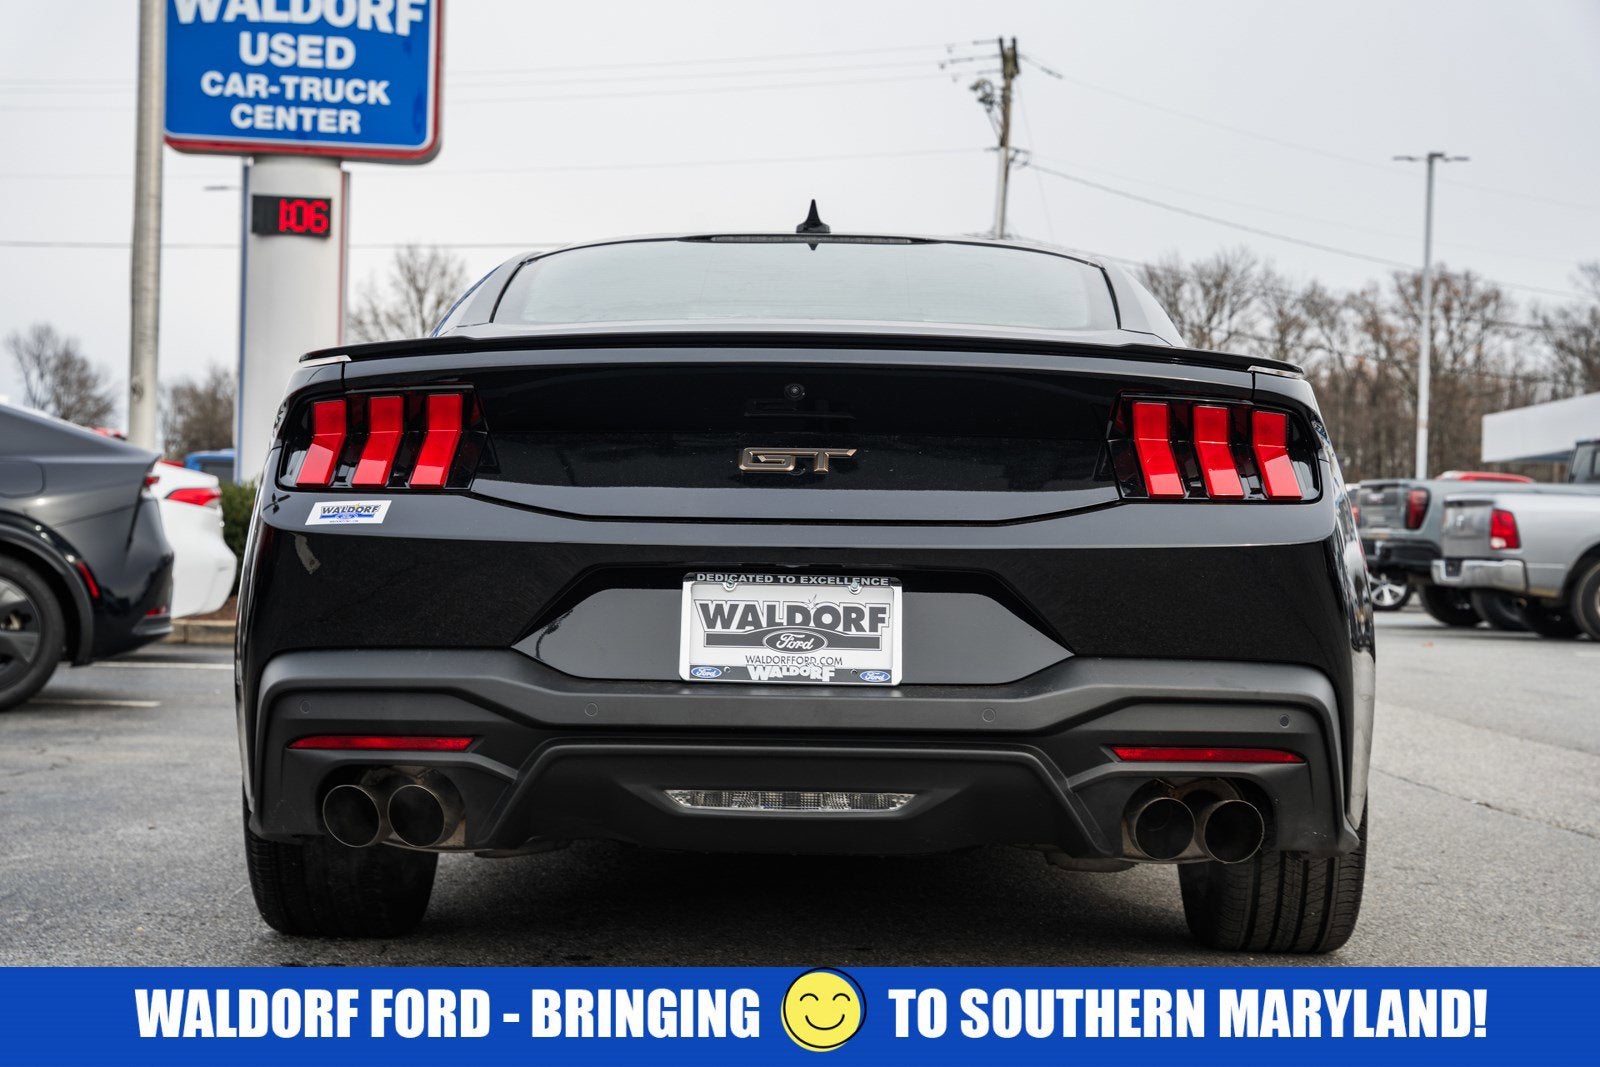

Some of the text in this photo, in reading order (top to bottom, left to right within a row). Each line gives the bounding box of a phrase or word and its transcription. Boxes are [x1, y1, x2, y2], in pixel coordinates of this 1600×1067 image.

[173, 0, 427, 36] WALDORF
[238, 31, 356, 70] USED
[200, 70, 391, 105] CAR-TRUCK
[230, 103, 361, 134] CENTER
[738, 446, 857, 474] GT
[321, 505, 380, 514] WALDORF
[696, 573, 889, 586] DEDICATED TO EXCELLENCE
[697, 600, 889, 633] WALDORF
[776, 632, 814, 651] Ford
[745, 655, 843, 666] WALDORFFORD.COM
[746, 664, 836, 682] WALDORF
